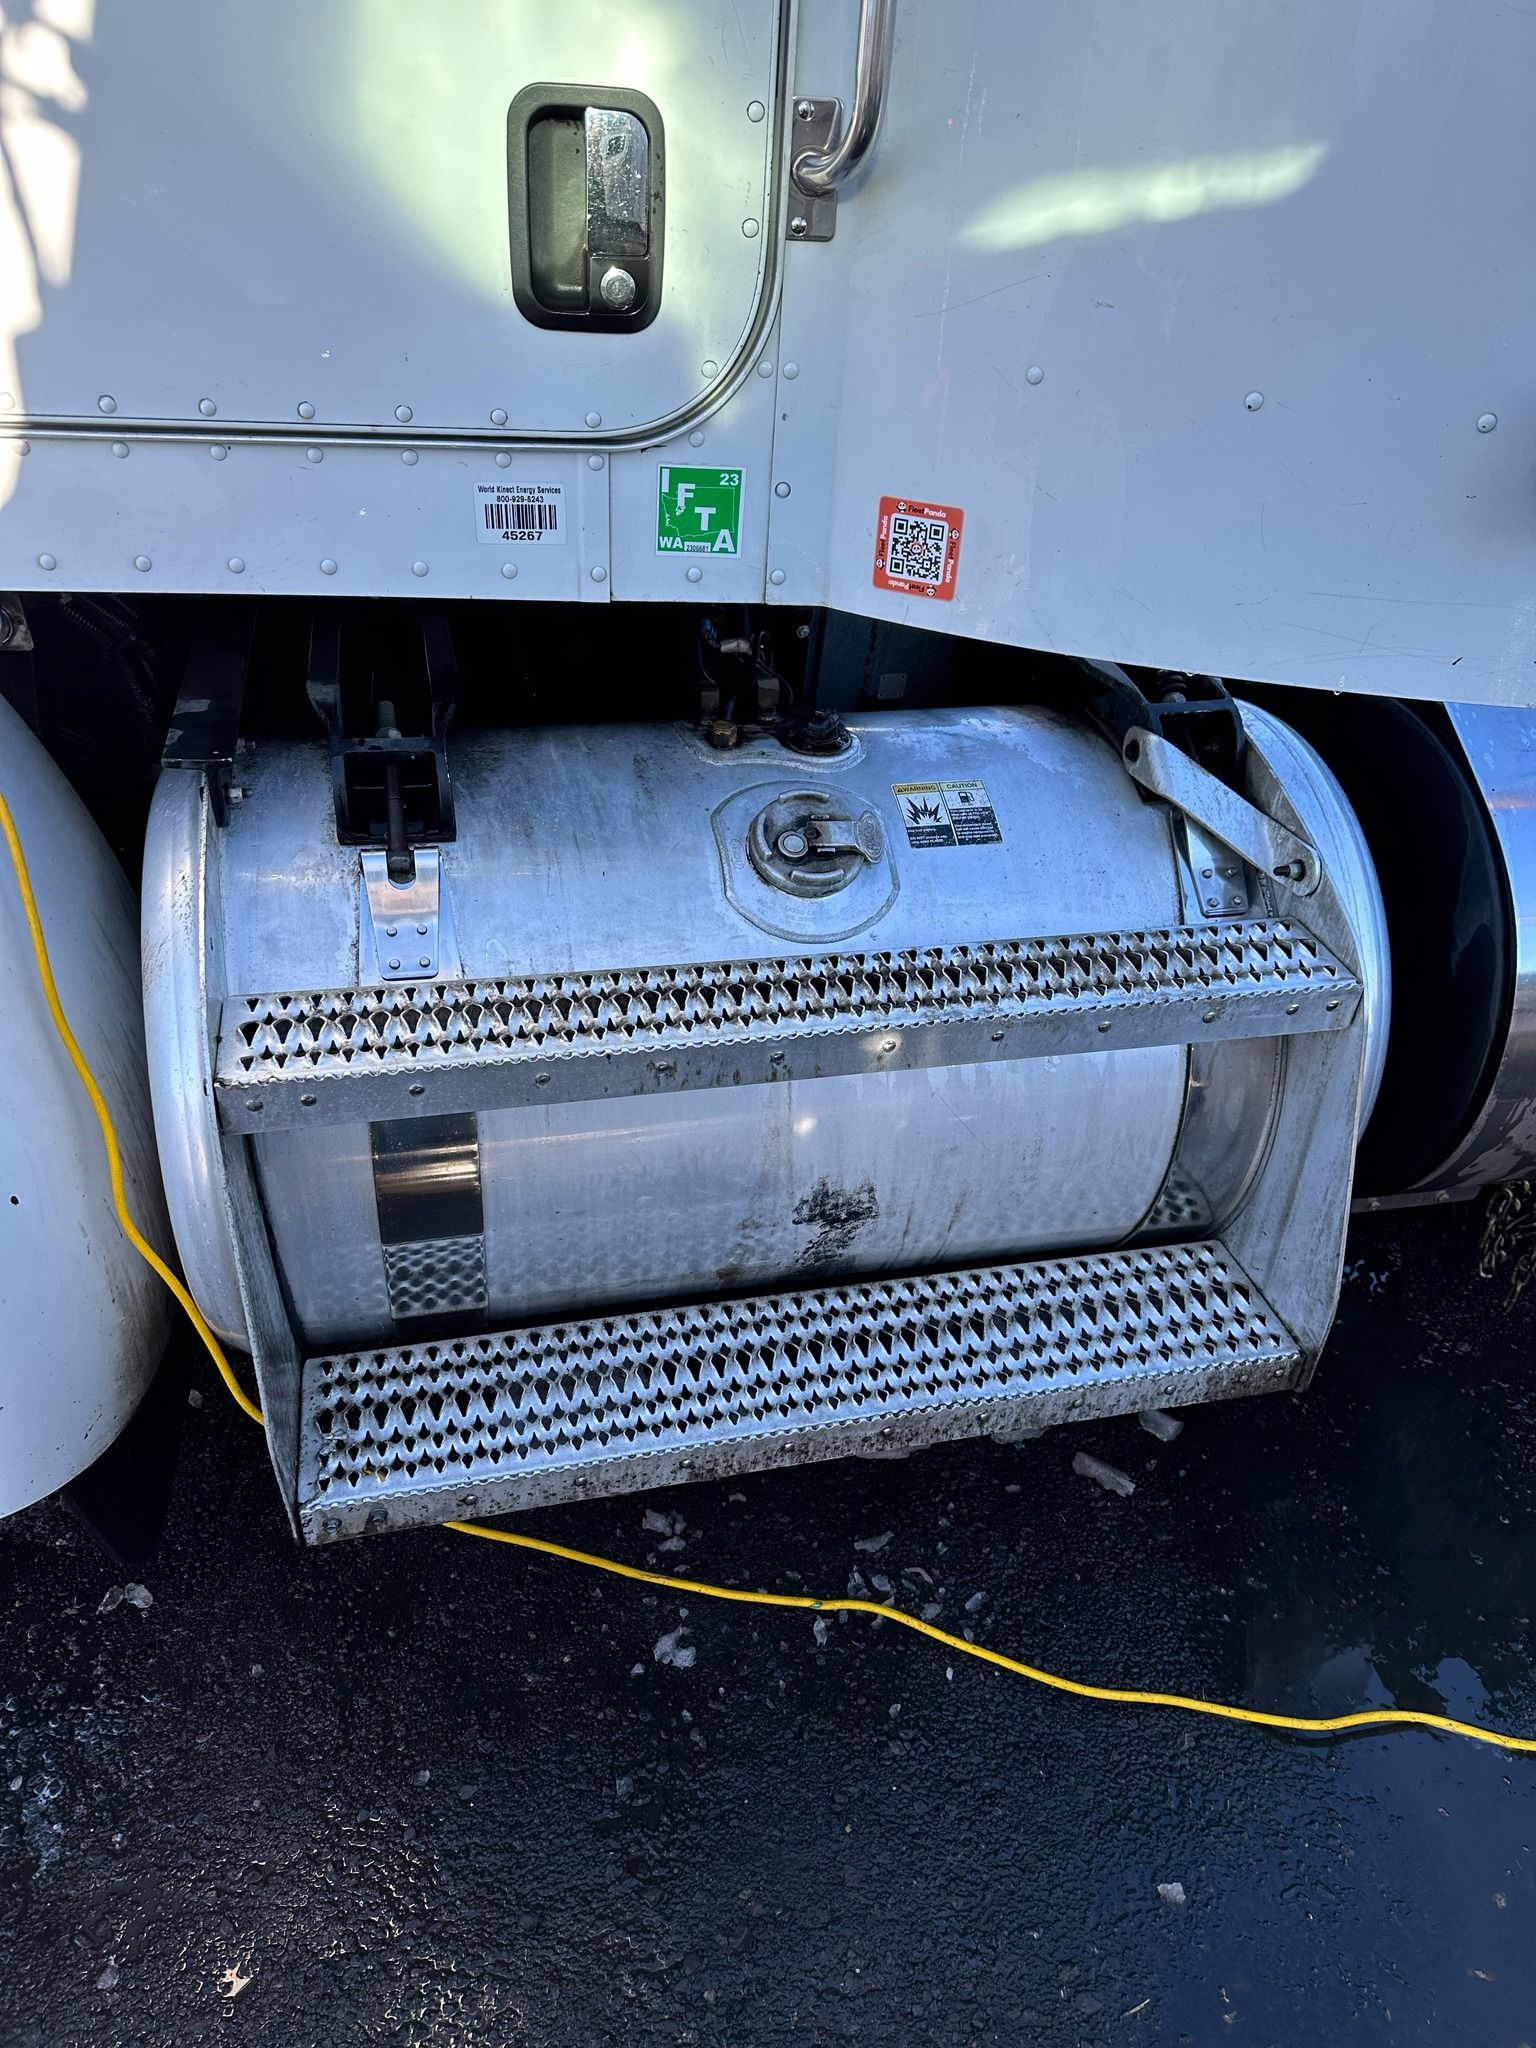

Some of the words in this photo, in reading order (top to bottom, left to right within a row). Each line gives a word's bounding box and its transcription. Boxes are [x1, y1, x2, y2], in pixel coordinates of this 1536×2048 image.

[719, 473, 739, 486] 23
[477, 485, 495, 494] World
[496, 485, 515, 494] Kinect
[516, 485, 536, 495] Energy
[537, 486, 562, 494] Services
[496, 495, 544, 503] 800-929-5243
[502, 530, 543, 541] 45267
[659, 536, 683, 549] WA
